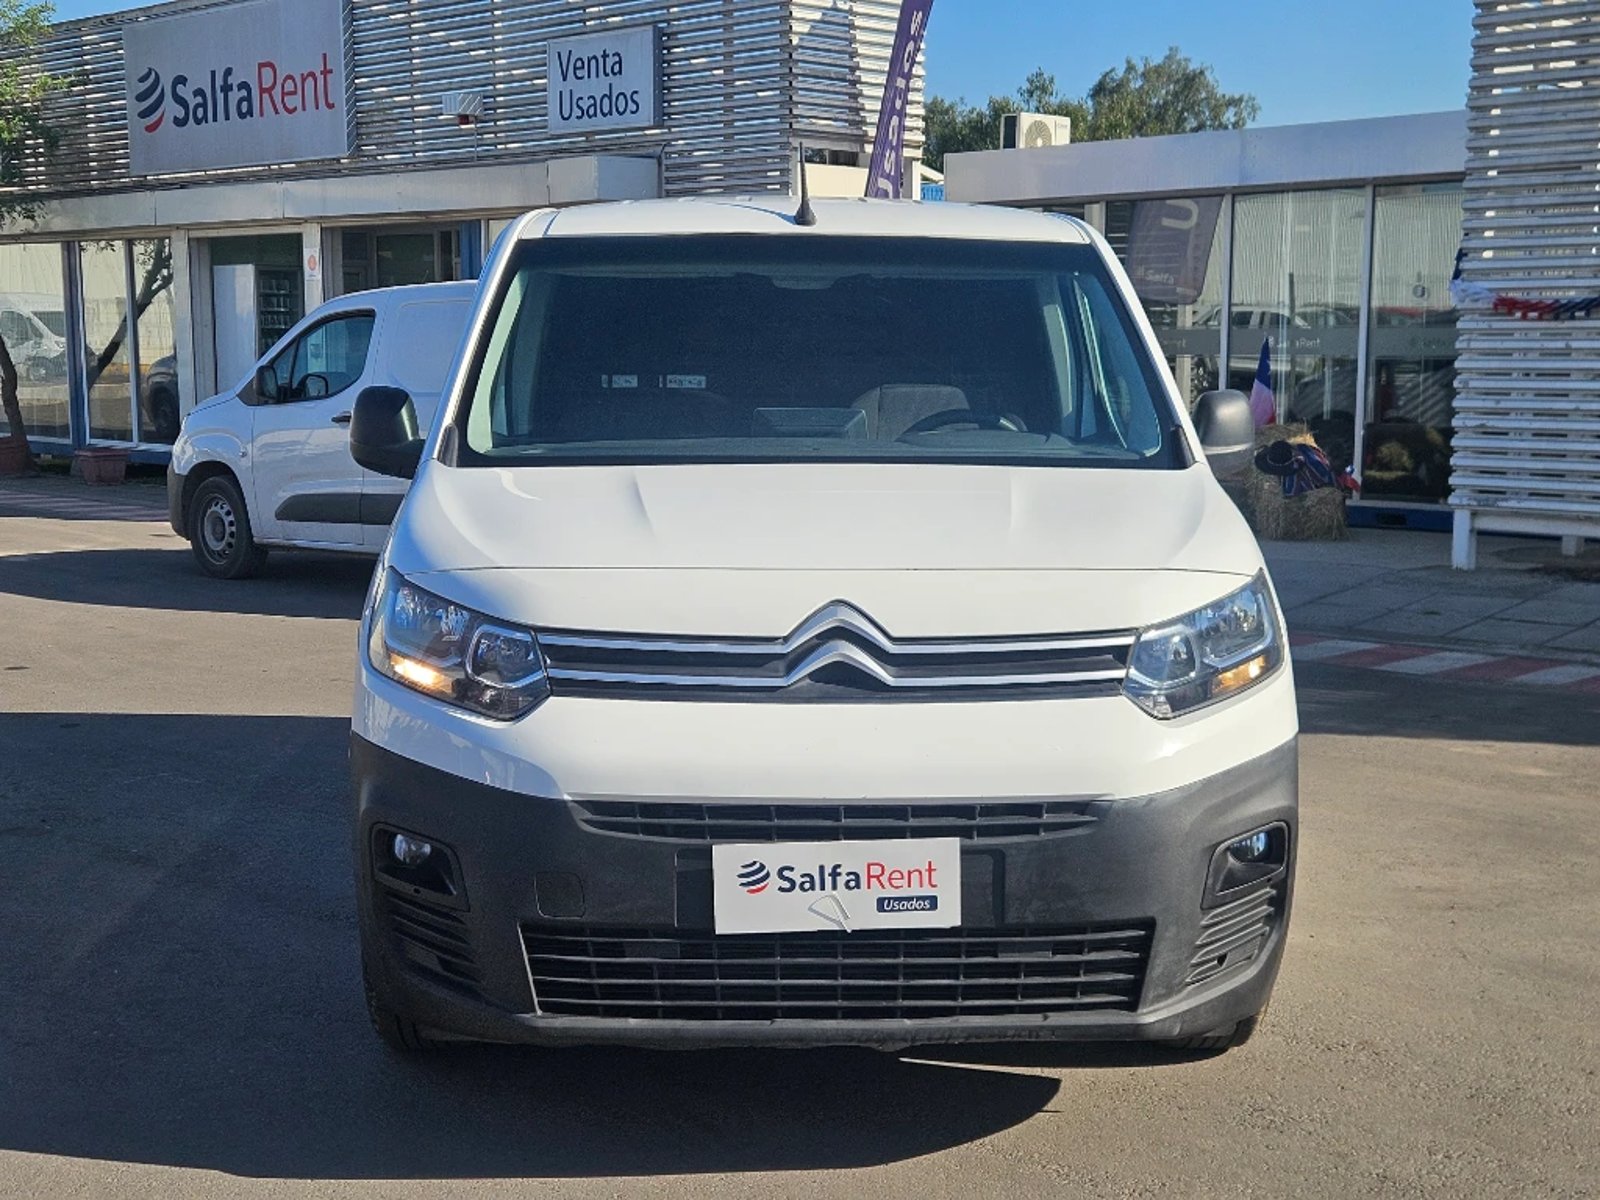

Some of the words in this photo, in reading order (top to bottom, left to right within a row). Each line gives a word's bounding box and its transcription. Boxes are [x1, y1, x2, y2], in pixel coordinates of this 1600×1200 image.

[557, 48, 623, 82] Venta
[171, 53, 335, 128] SalfaRent
[559, 83, 640, 121] Usados
[777, 860, 938, 893] SalfaRent
[883, 898, 931, 911] Usados
